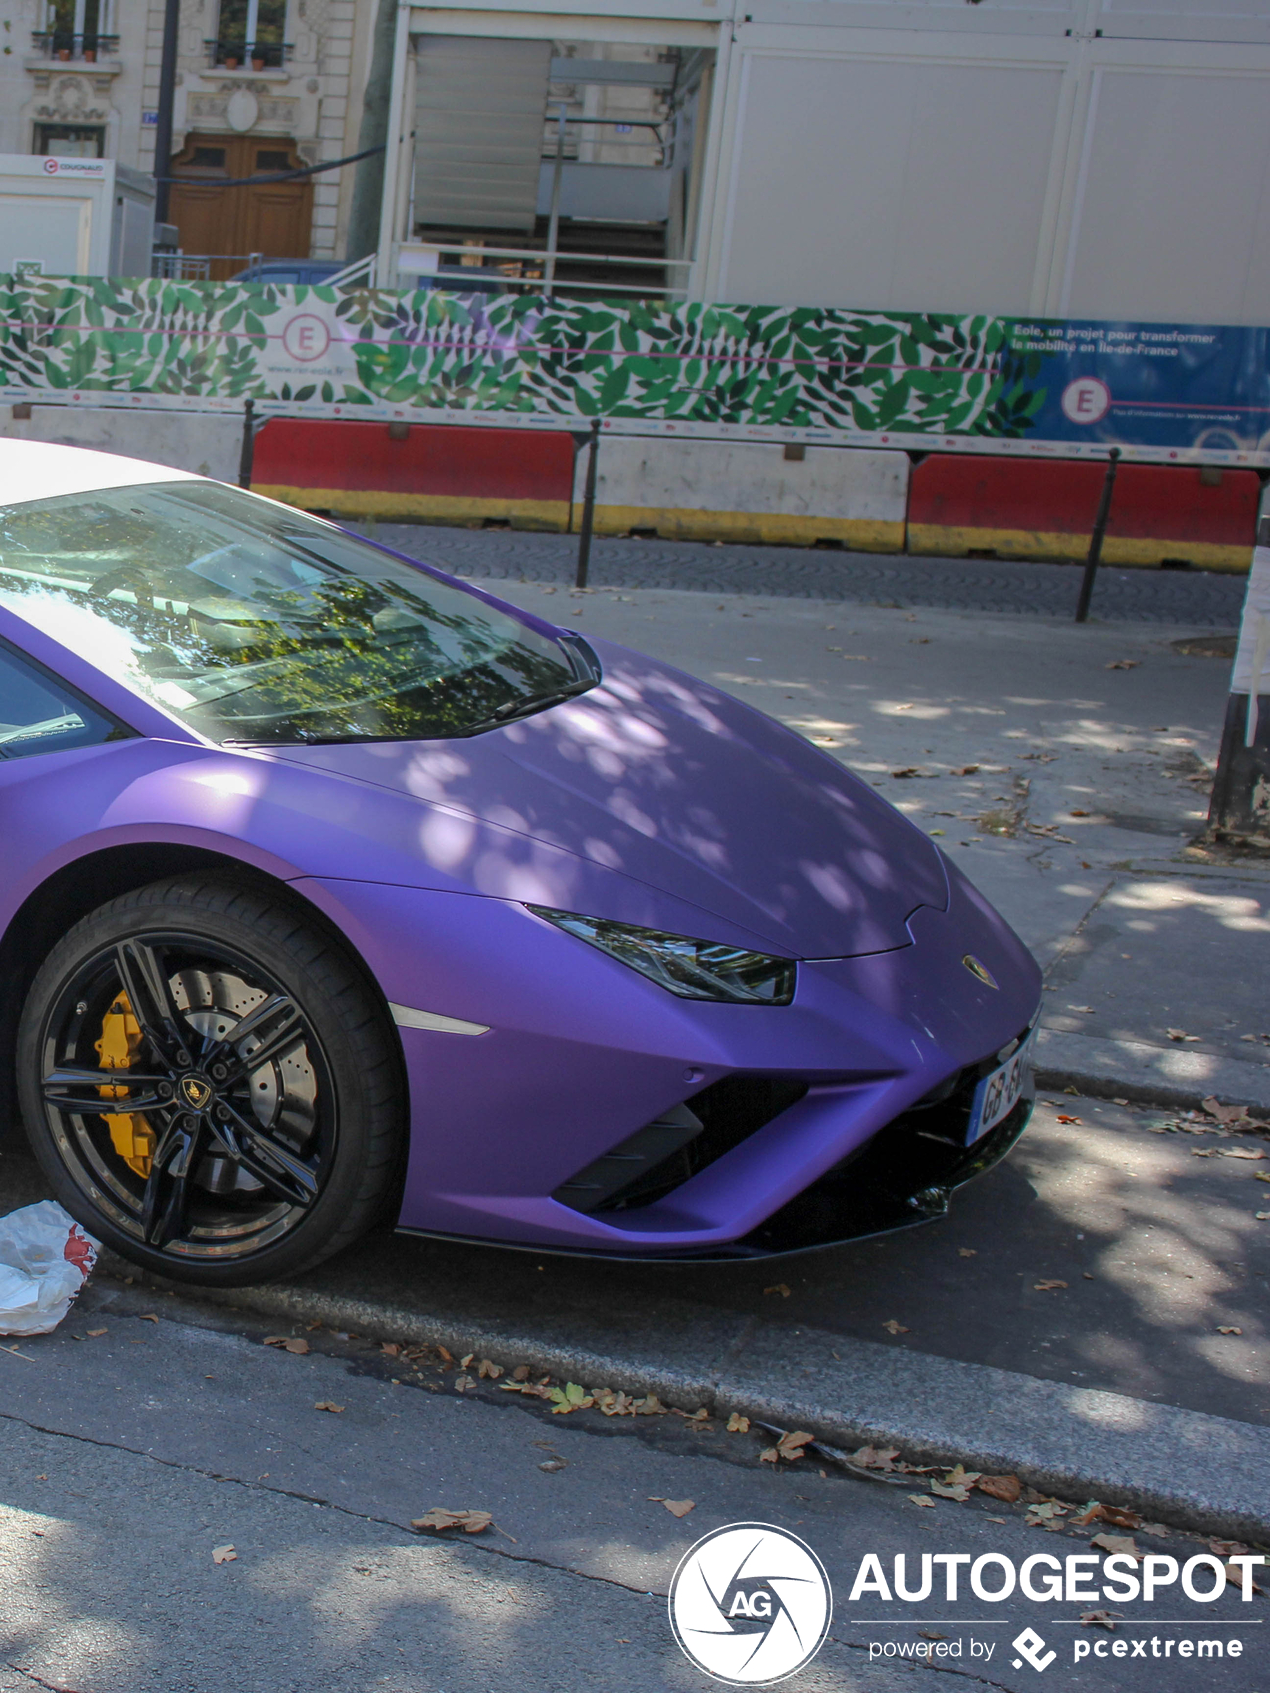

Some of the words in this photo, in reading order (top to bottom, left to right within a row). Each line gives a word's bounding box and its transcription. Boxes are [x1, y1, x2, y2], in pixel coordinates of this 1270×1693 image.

[298, 327, 314, 350] E
[1014, 325, 1045, 339] Eole,
[1048, 328, 1063, 338] un
[1067, 328, 1105, 342] projet
[1108, 330, 1137, 343] pour
[1141, 331, 1216, 344] transformer
[1012, 338, 1023, 350] la
[1026, 340, 1076, 352] mobilité
[1080, 343, 1096, 353] en
[1099, 342, 1179, 356] Île-de-France
[1077, 390, 1094, 413] E
